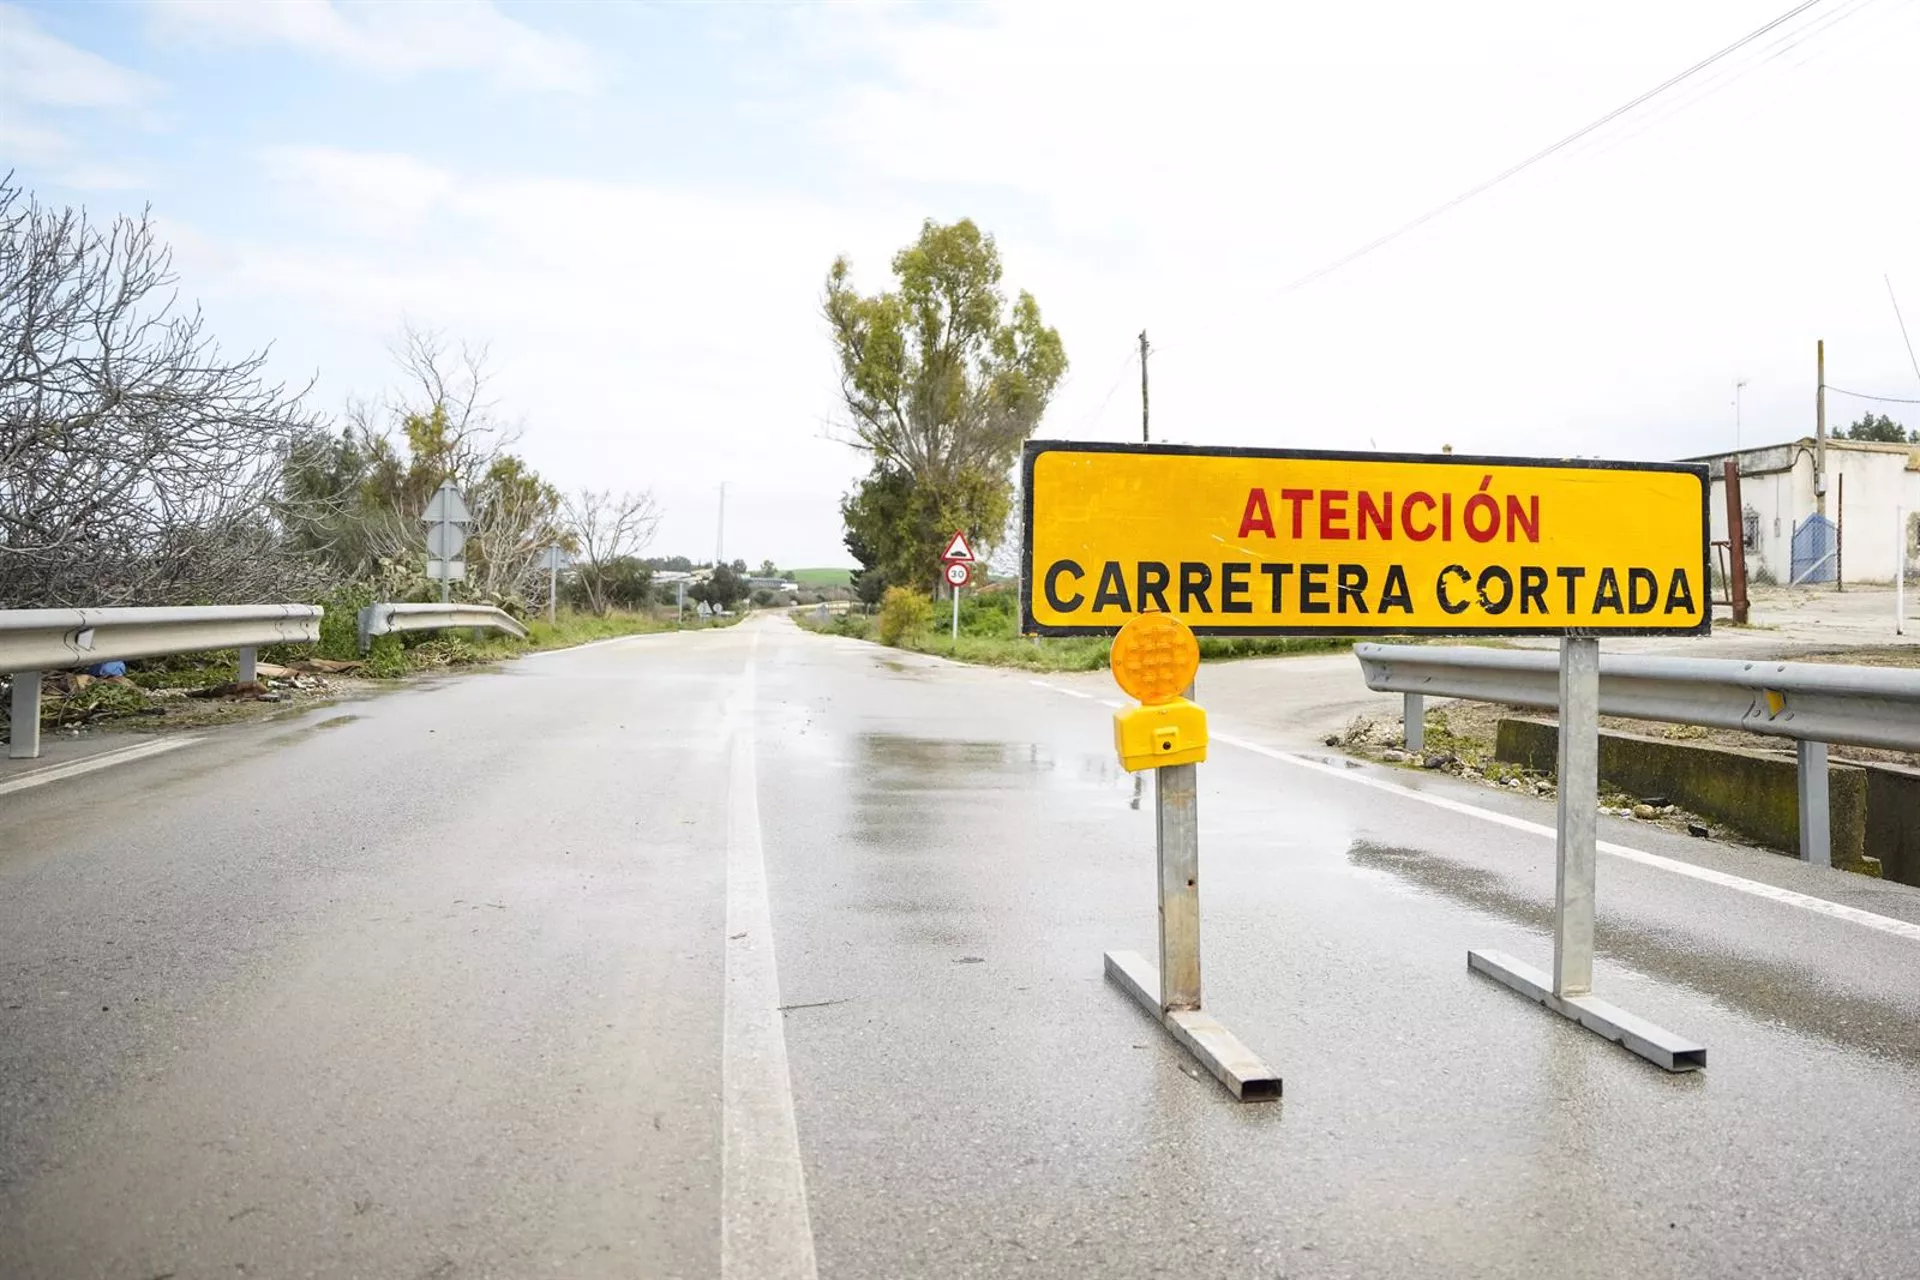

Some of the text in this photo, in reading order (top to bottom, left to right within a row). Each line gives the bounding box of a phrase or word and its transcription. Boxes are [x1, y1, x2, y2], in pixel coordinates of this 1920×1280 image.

[1238, 475, 1539, 543] ATENCIÓN
[951, 570, 964, 578] 30
[1044, 559, 1696, 615] CARRETERA CORTADA
